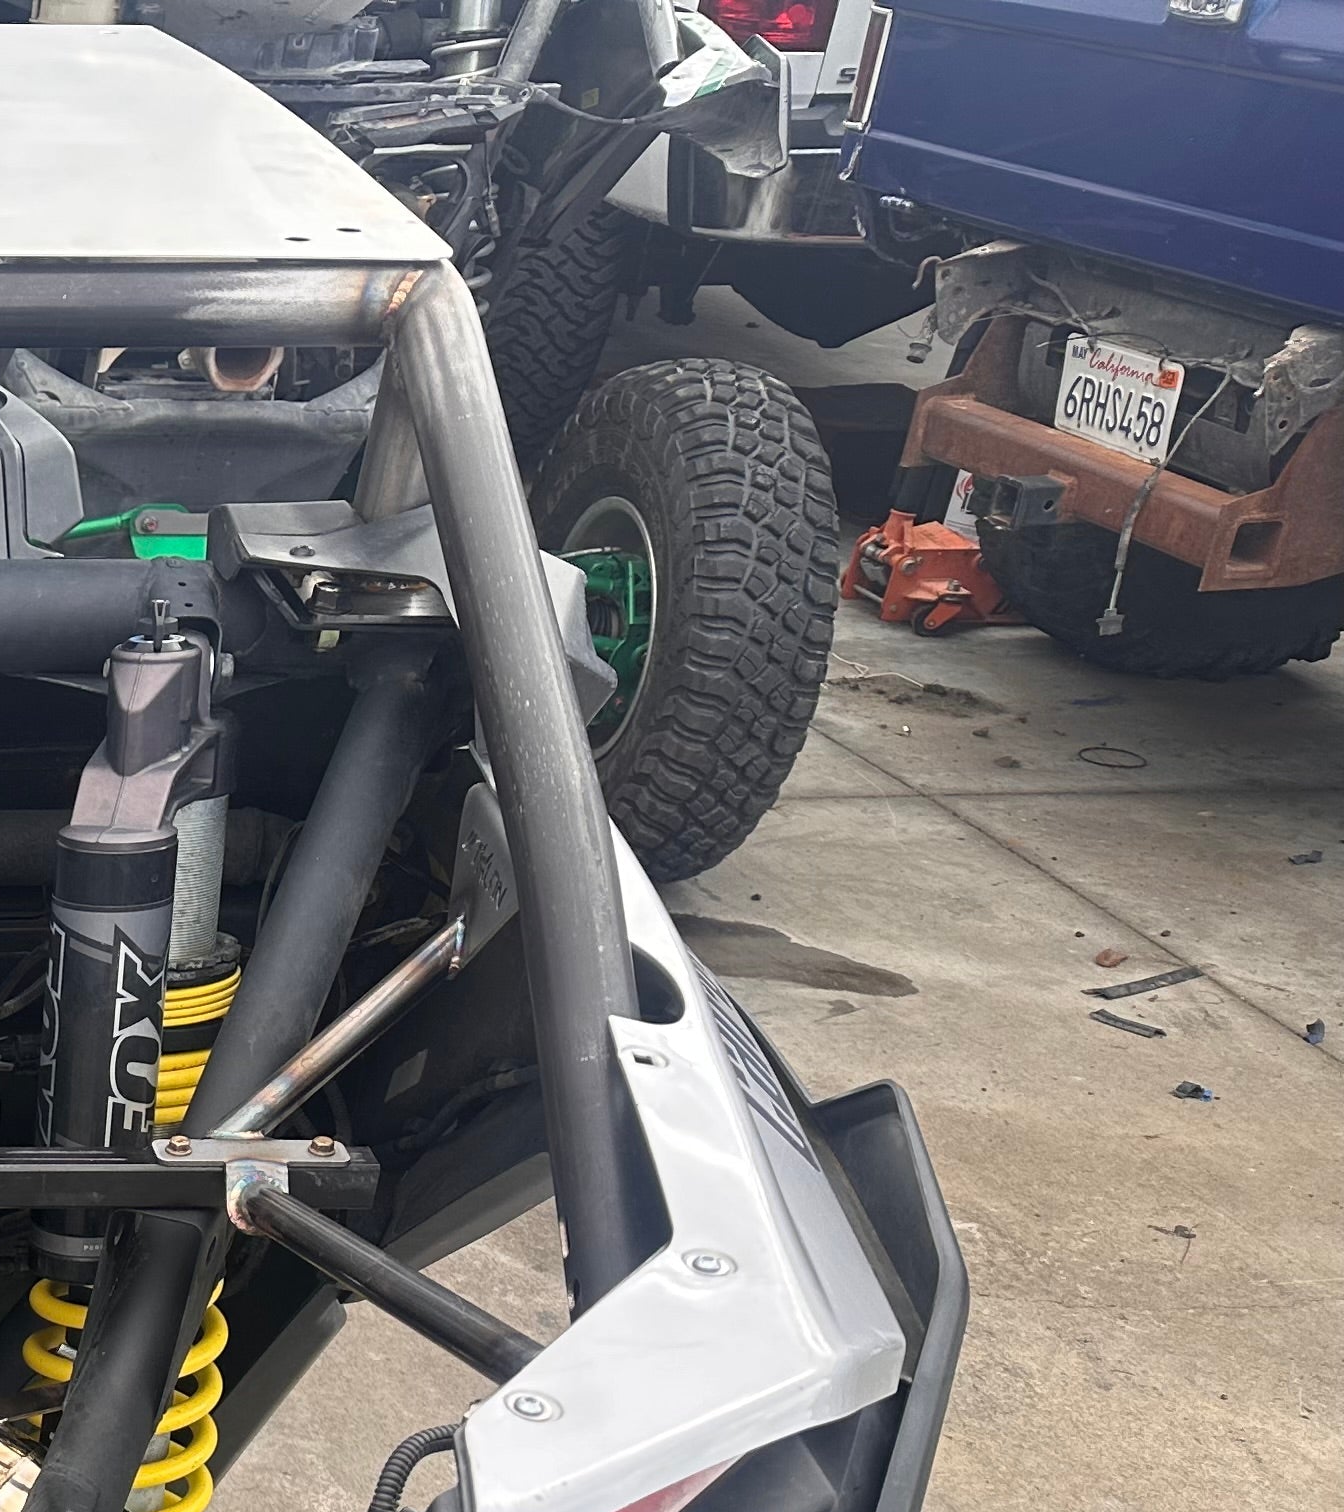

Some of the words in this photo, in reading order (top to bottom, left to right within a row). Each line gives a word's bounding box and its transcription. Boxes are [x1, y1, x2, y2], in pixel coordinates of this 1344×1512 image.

[1072, 345, 1088, 359] MAY
[1089, 348, 1154, 383] California
[1064, 375, 1165, 447] 6RHS458
